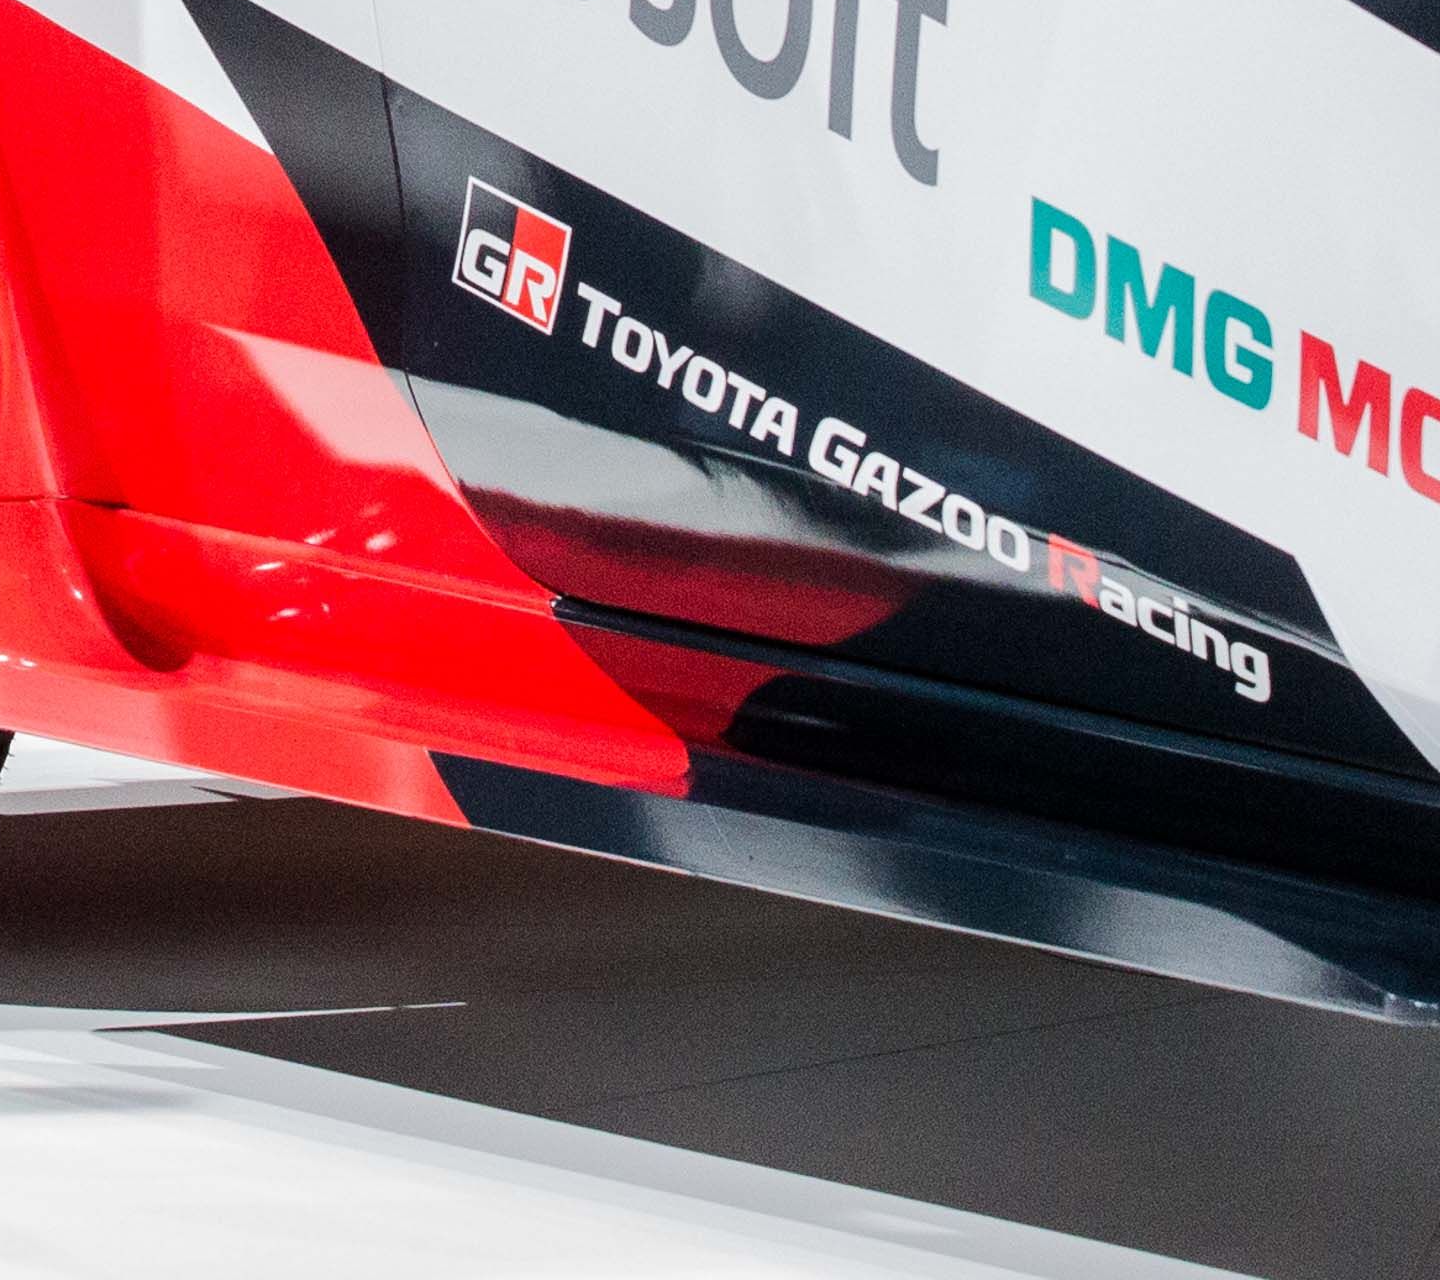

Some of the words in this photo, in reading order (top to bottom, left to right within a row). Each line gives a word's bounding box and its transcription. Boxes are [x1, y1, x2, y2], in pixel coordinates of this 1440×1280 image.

[459, 228, 562, 322] GR
[1029, 195, 1275, 411] DMG
[577, 282, 797, 458] TOYOTA
[808, 418, 1029, 573] GAZOO
[1048, 533, 1271, 703] Racing
